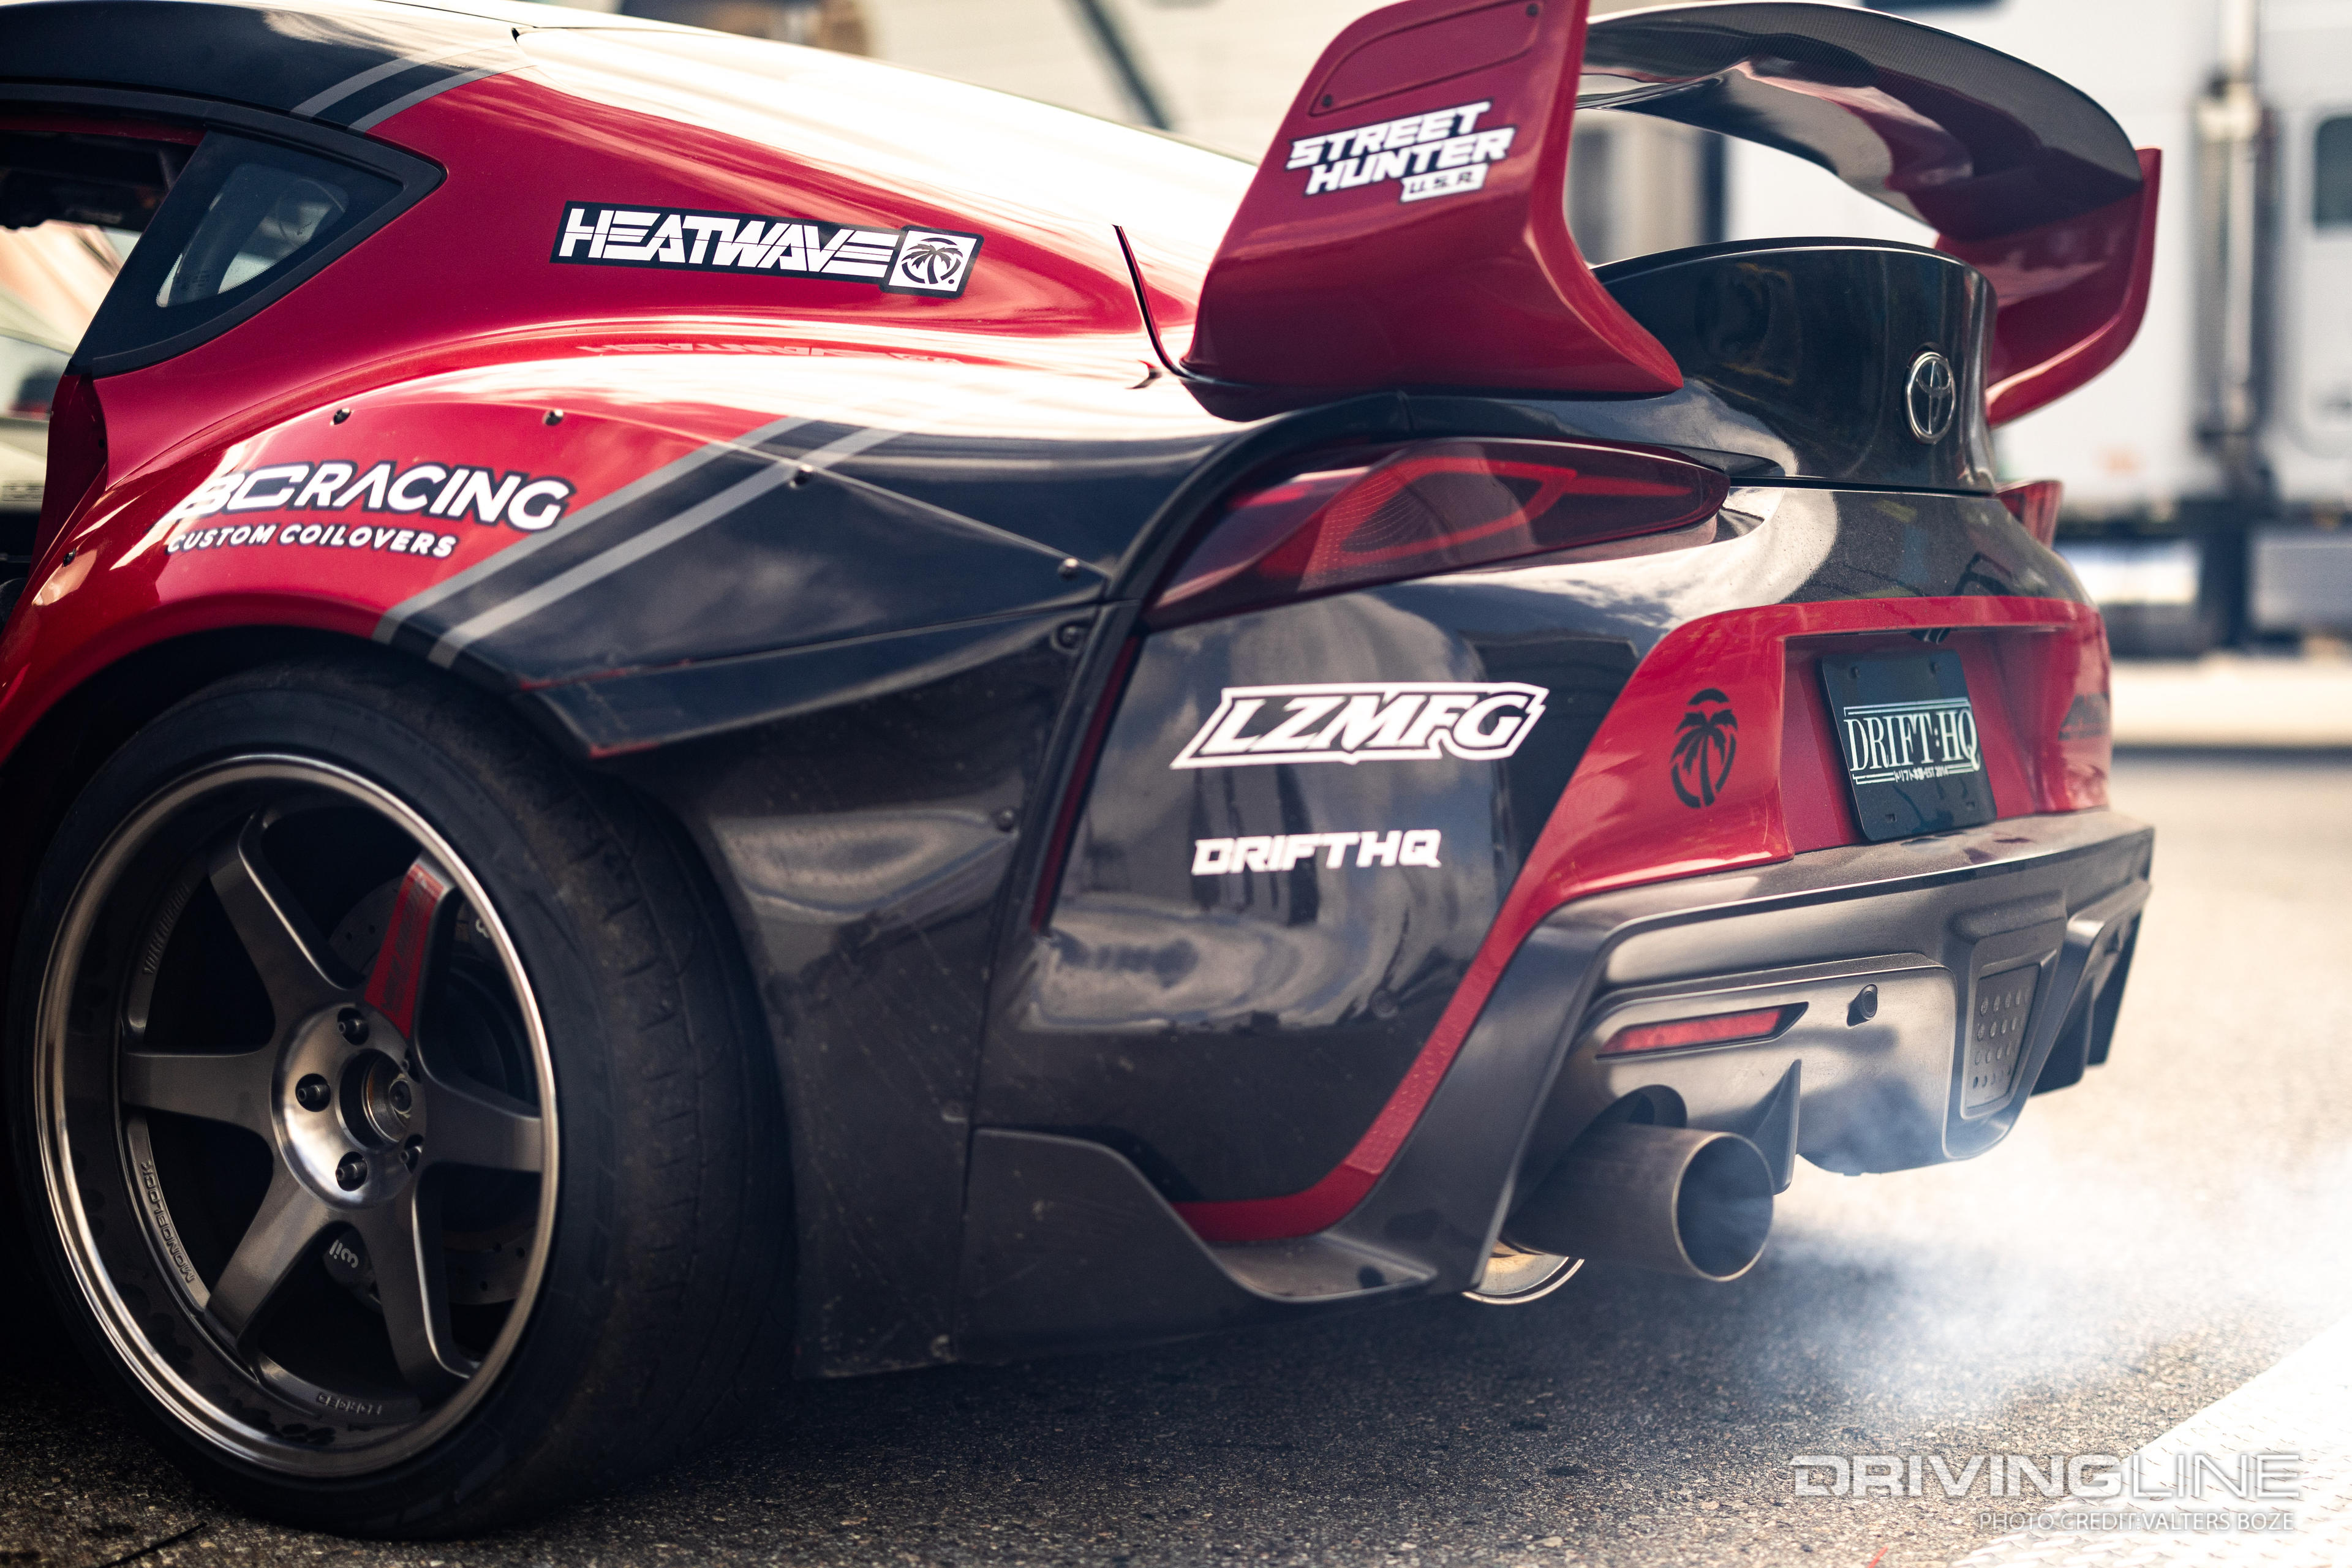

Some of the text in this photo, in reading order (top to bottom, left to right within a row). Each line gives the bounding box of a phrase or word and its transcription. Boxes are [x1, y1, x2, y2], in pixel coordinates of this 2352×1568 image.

[1286, 101, 1491, 170] STREET
[1305, 126, 1517, 195] HUNTER
[559, 208, 900, 278] HEATWAVE
[167, 523, 457, 558] CUSTOM COILOVERS
[1197, 693, 1530, 756] LZMFG
[1191, 829, 1442, 876] DRIFTHQ
[140, 1159, 196, 1283] MONOBLOCK
